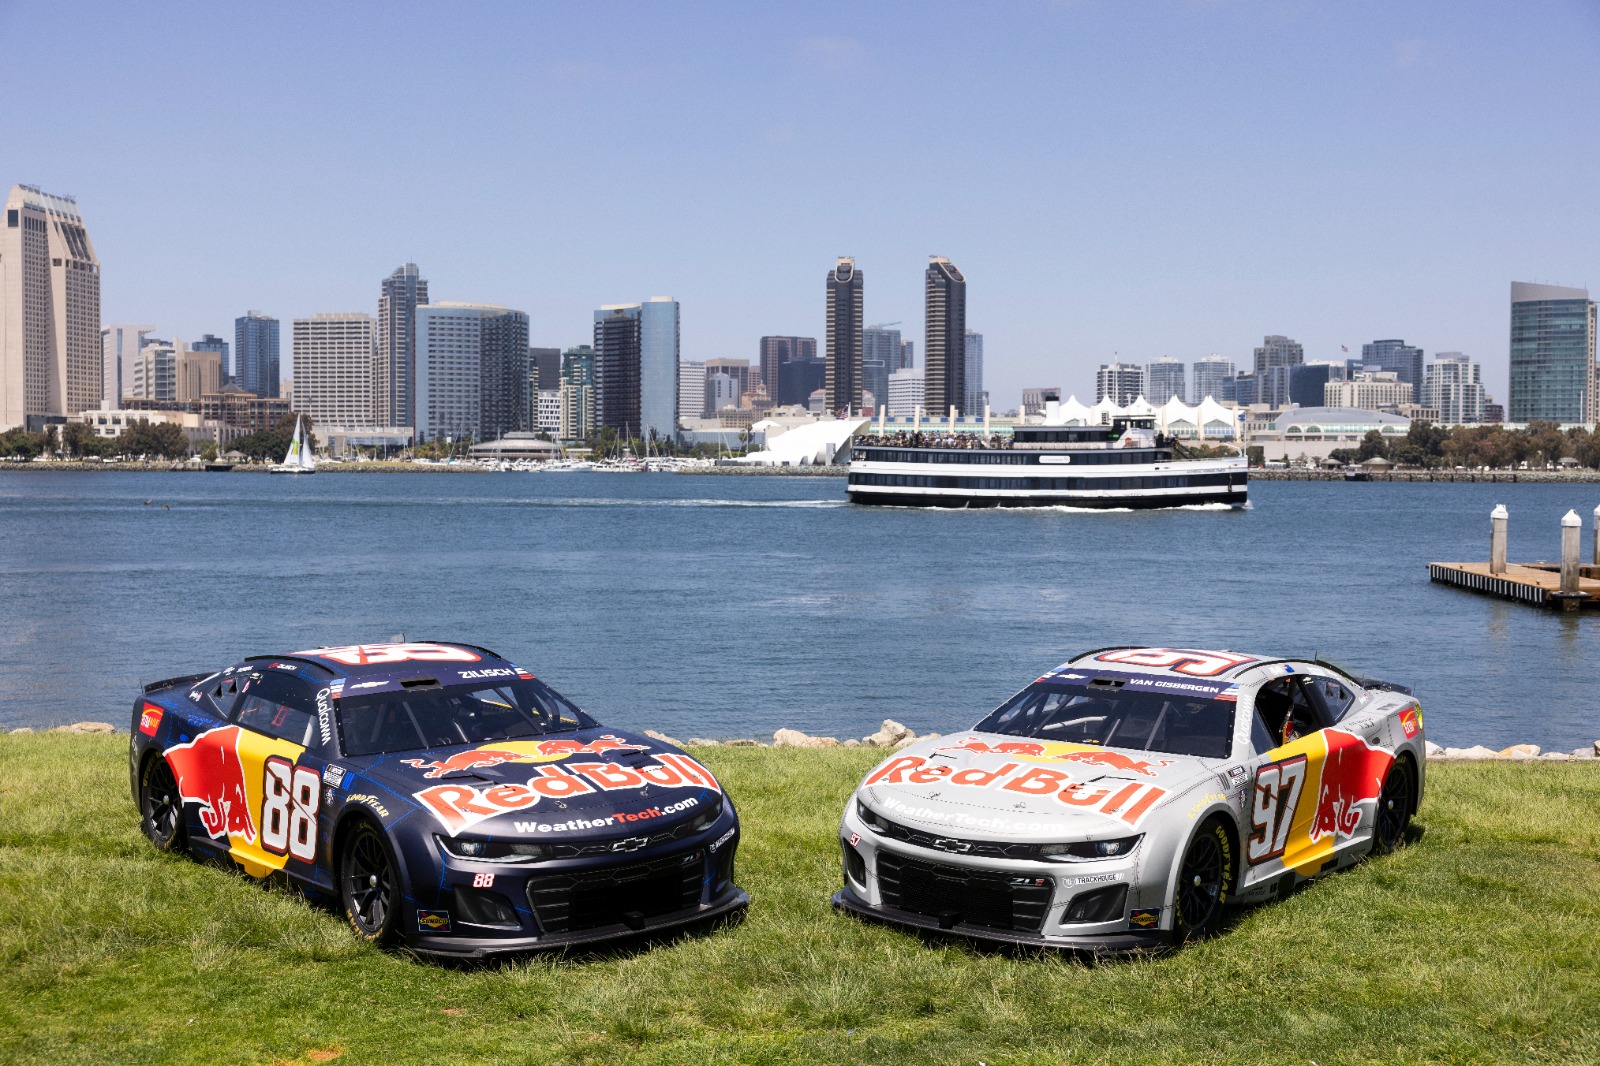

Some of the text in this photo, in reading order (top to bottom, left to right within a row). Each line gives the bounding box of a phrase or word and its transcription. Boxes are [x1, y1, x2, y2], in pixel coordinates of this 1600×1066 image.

[457, 668, 515, 679] ZILISCH
[1130, 678, 1219, 693] VAN GISBERGEN
[315, 687, 331, 746] Qualcomm
[1235, 694, 1252, 745] Qualcomm
[412, 764, 597, 837] Red
[568, 752, 722, 792] Bull
[860, 755, 1173, 831] Red Bull
[262, 756, 321, 865] 88
[1247, 753, 1308, 868] 97
[850, 832, 861, 847] 97
[472, 873, 495, 888] 88
[1010, 877, 1045, 886] ZL1
[1077, 873, 1118, 884] TRACKHOUSE
